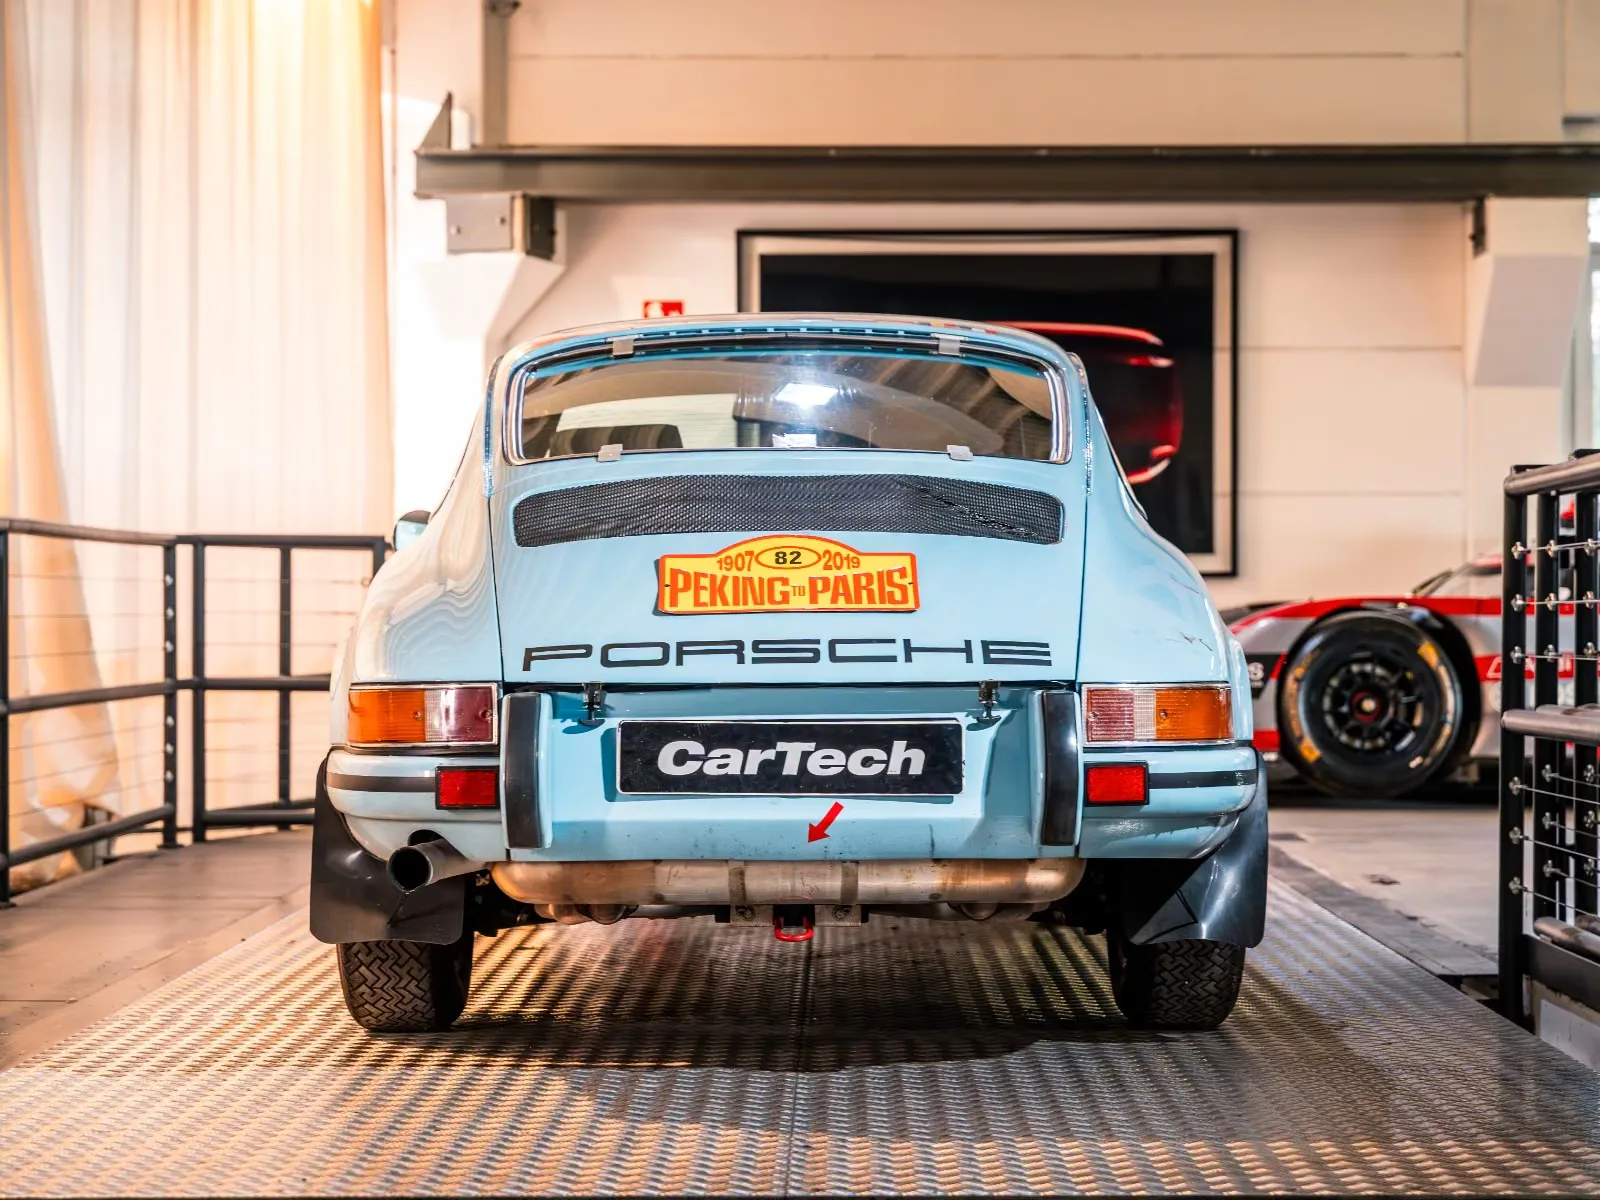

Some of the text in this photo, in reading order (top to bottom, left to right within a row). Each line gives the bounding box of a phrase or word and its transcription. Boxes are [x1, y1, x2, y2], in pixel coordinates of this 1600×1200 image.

[716, 550, 861, 572] 1907 82 2019
[669, 566, 908, 608] PEKING TO PARIS
[522, 638, 1052, 672] PORSCHE
[657, 740, 926, 776] CarTech
